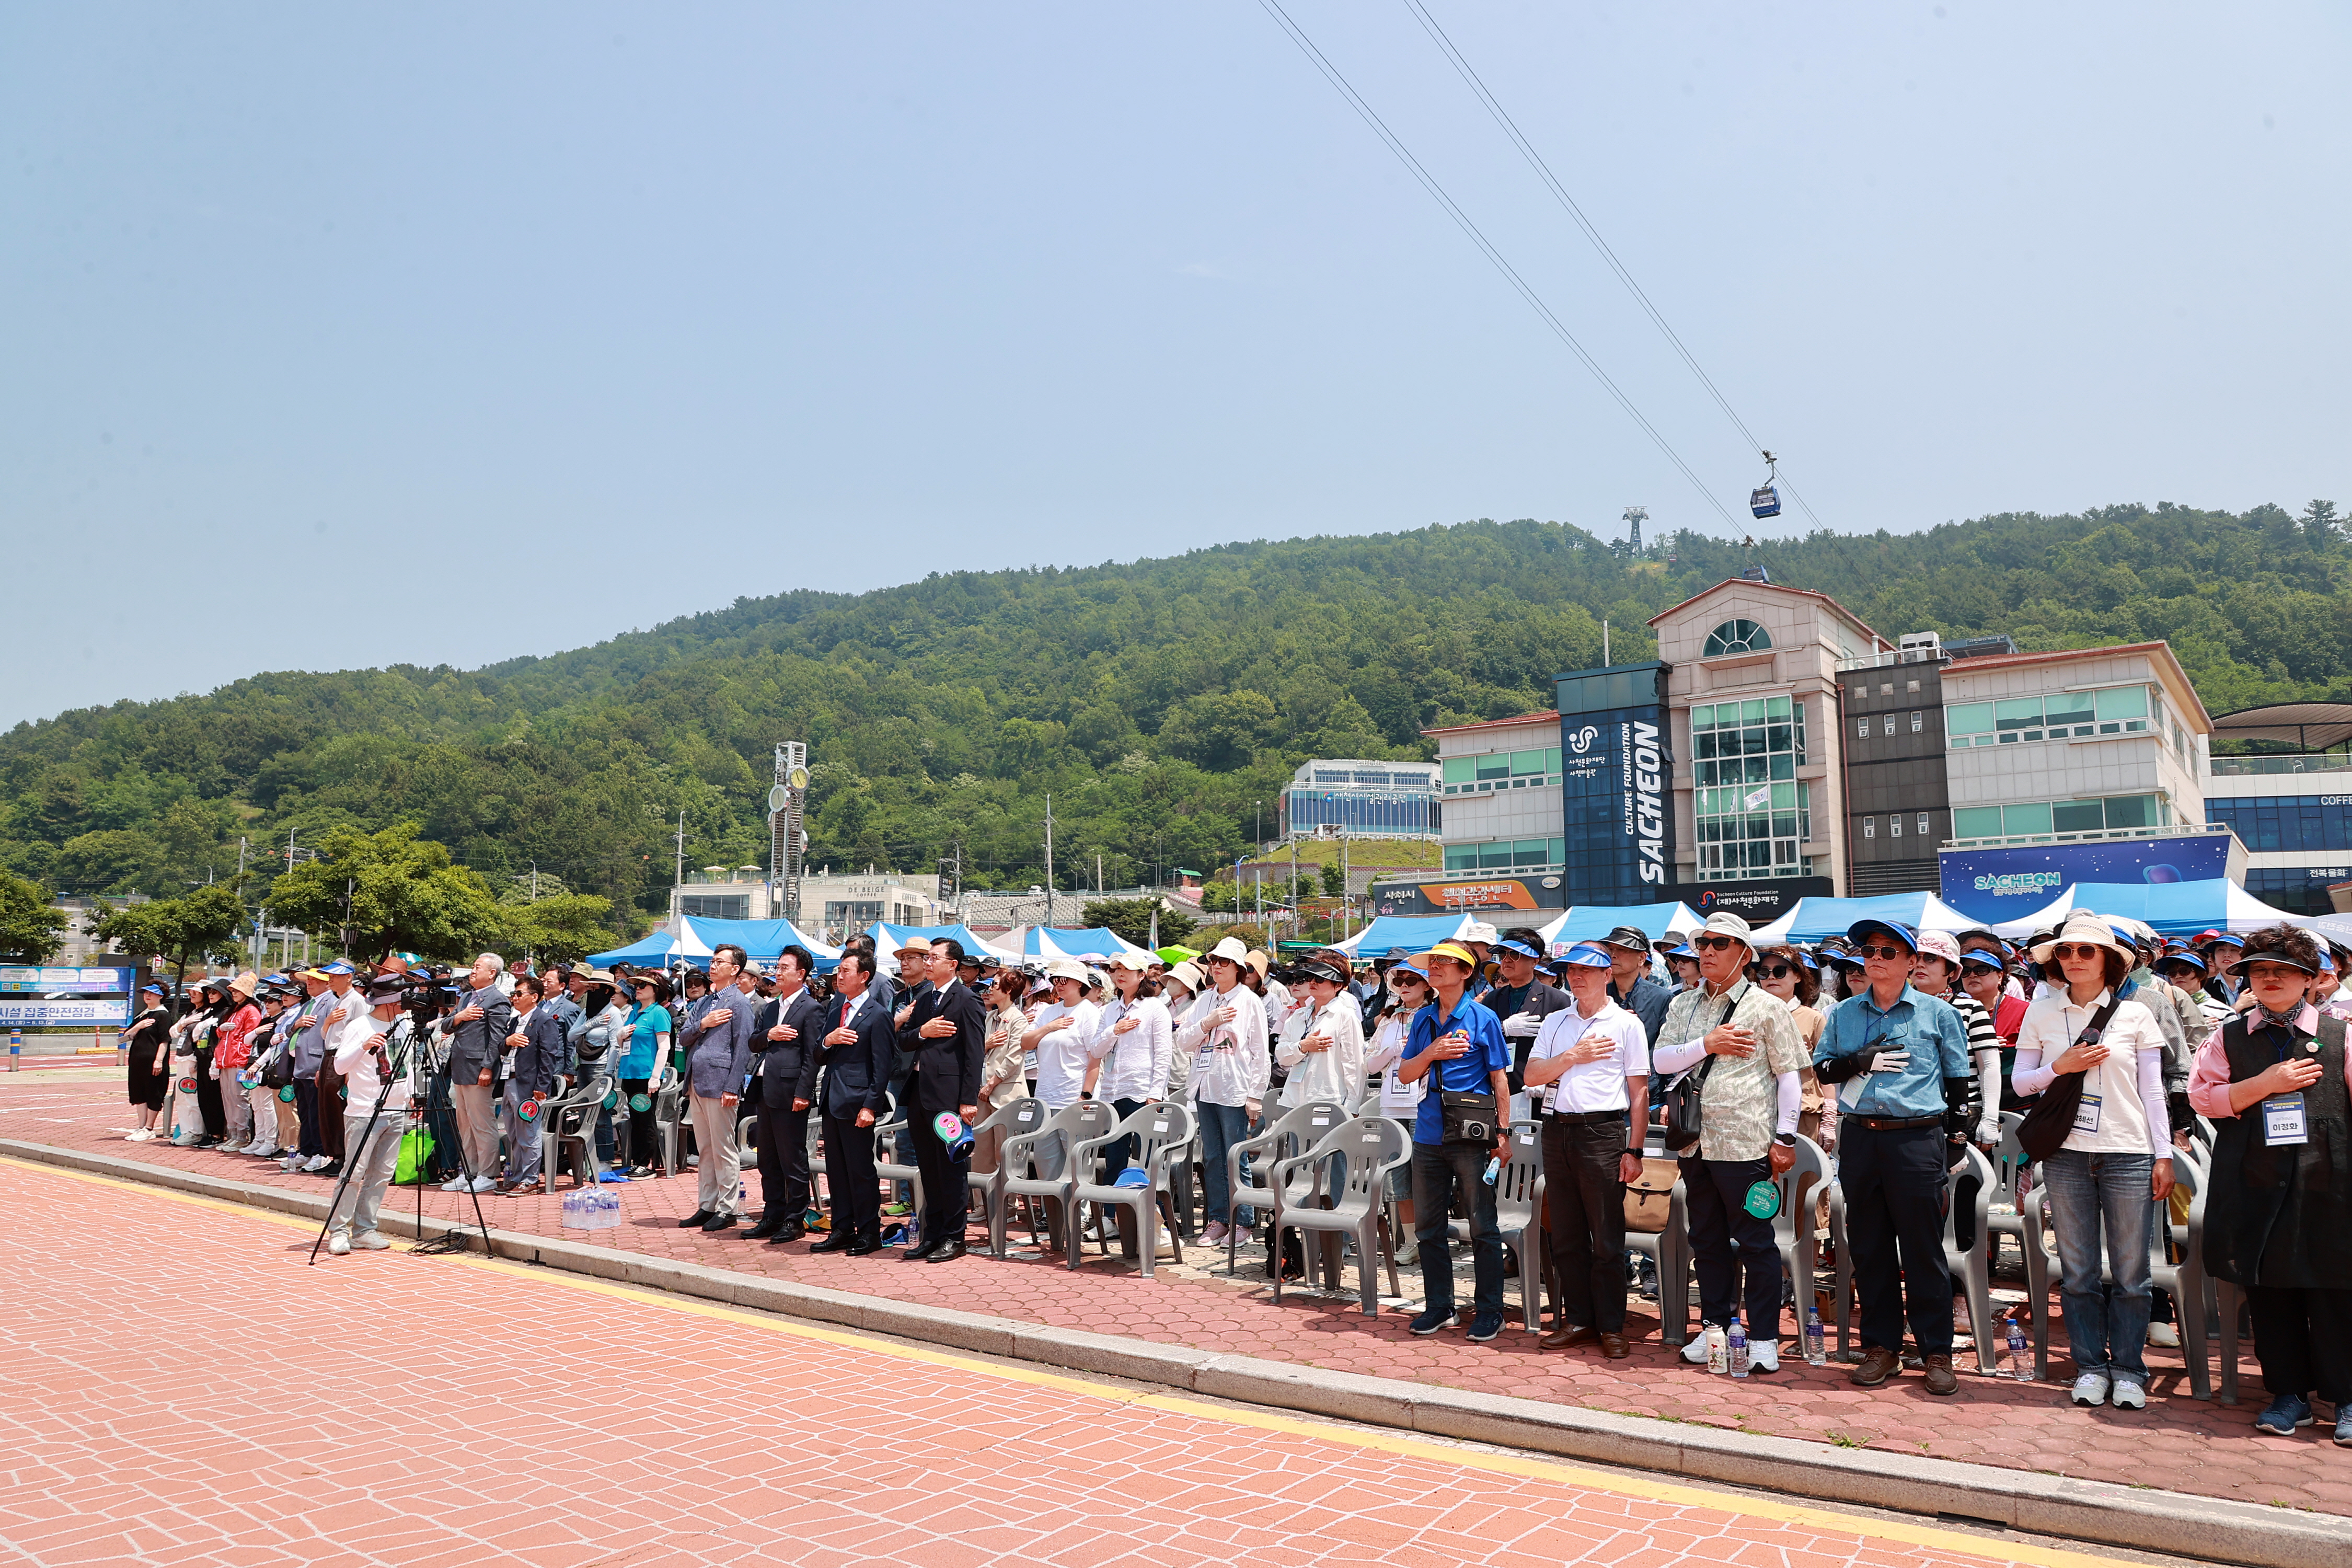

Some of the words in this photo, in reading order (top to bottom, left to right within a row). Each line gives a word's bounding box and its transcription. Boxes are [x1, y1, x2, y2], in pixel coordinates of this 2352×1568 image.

[1622, 723, 1632, 787] FOUNDATION
[1569, 756, 1606, 767] 사천문화재단
[1570, 768, 1597, 778] 사천미술관
[1335, 792, 1406, 805] 사천시시설관리공단
[1634, 721, 1664, 885] SACHEON
[1625, 790, 1634, 835] CULTURE
[2309, 869, 2346, 878] 전복물회
[1974, 872, 2061, 890] SACHEON
[1384, 890, 1415, 905] 사천시
[1442, 884, 1512, 903] 체험관광센터
[1716, 896, 1779, 908] (재)사천문화재단
[25, 1007, 95, 1018] 집중안전점검
[2273, 1122, 2298, 1131] 이정화
